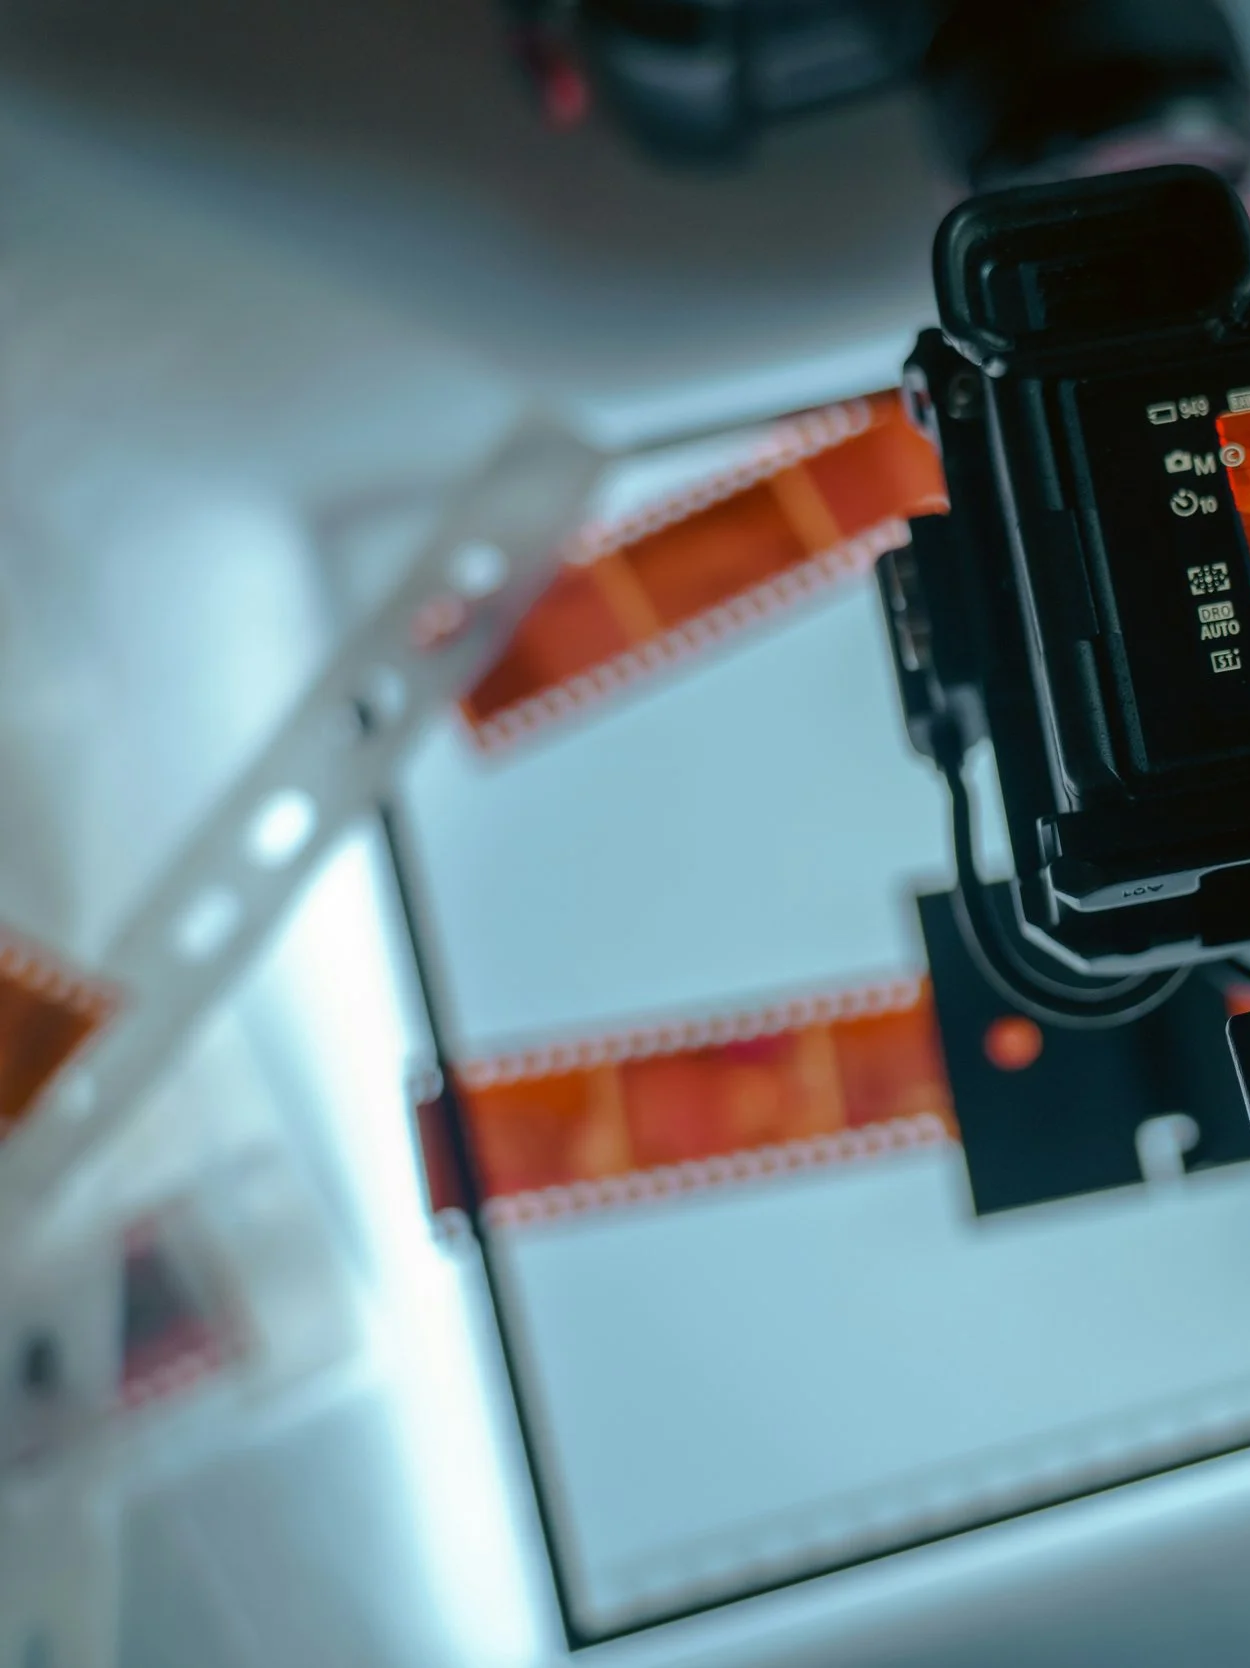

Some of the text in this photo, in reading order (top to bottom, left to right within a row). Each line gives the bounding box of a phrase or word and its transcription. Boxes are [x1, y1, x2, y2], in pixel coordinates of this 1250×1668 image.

[1194, 452, 1217, 476] M
[1200, 496, 1218, 514] 10
[1201, 604, 1232, 622] DRO
[1201, 619, 1241, 641] AUTO
